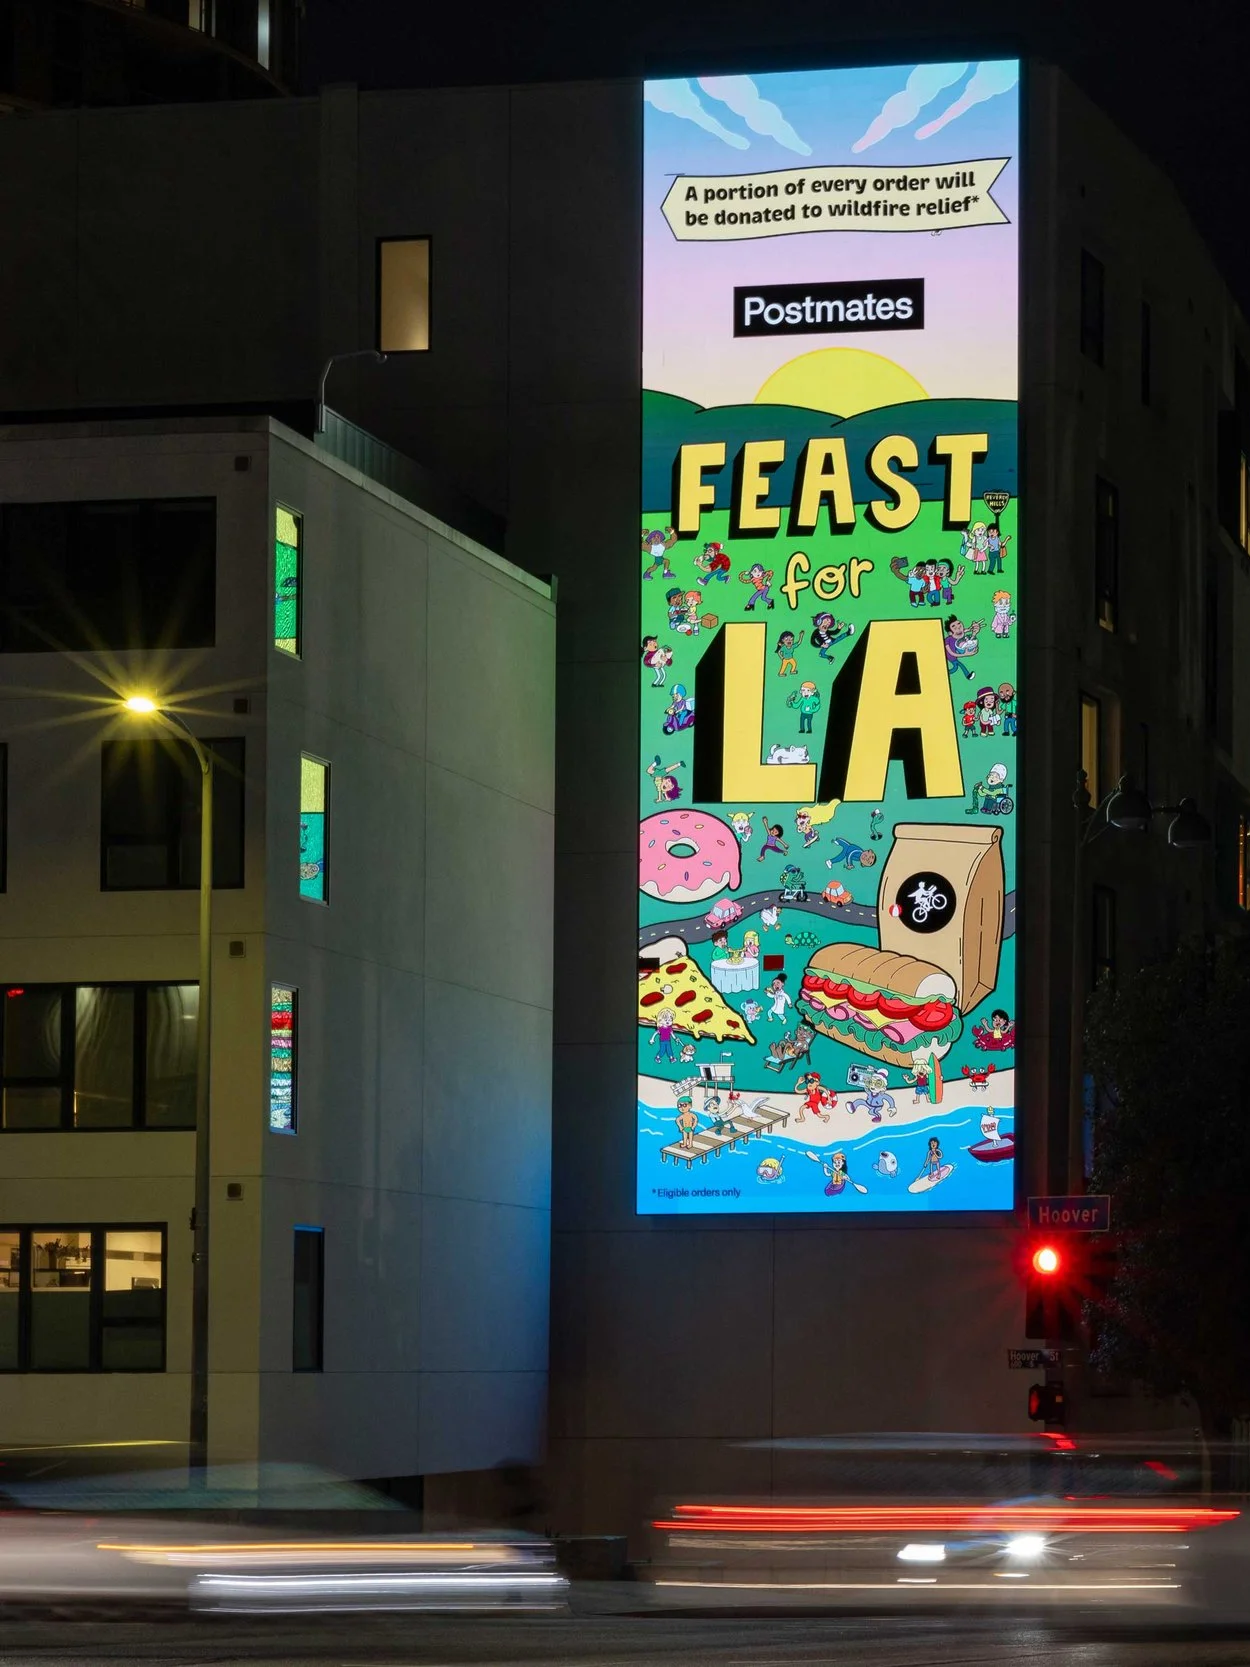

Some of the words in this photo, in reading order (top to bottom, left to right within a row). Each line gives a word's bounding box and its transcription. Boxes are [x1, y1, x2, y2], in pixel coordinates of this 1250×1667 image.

[684, 185, 698, 202] A
[703, 184, 779, 205] portion
[784, 178, 806, 198] of
[811, 175, 867, 196] every
[872, 172, 931, 191] order
[935, 171, 976, 190] will
[684, 208, 709, 227] be
[714, 203, 796, 227] donated
[801, 203, 823, 220] to
[829, 198, 911, 218] wildfire
[743, 295, 914, 327] Postmates
[672, 432, 989, 541] FEAST
[779, 550, 875, 611] for
[692, 617, 966, 805] LA
[691, 1186, 720, 1197] orders
[722, 1186, 741, 1198] only
[1038, 1205, 1099, 1224] Hoover
[1010, 1351, 1039, 1362] Hoover
[1049, 1351, 1059, 1362] St
